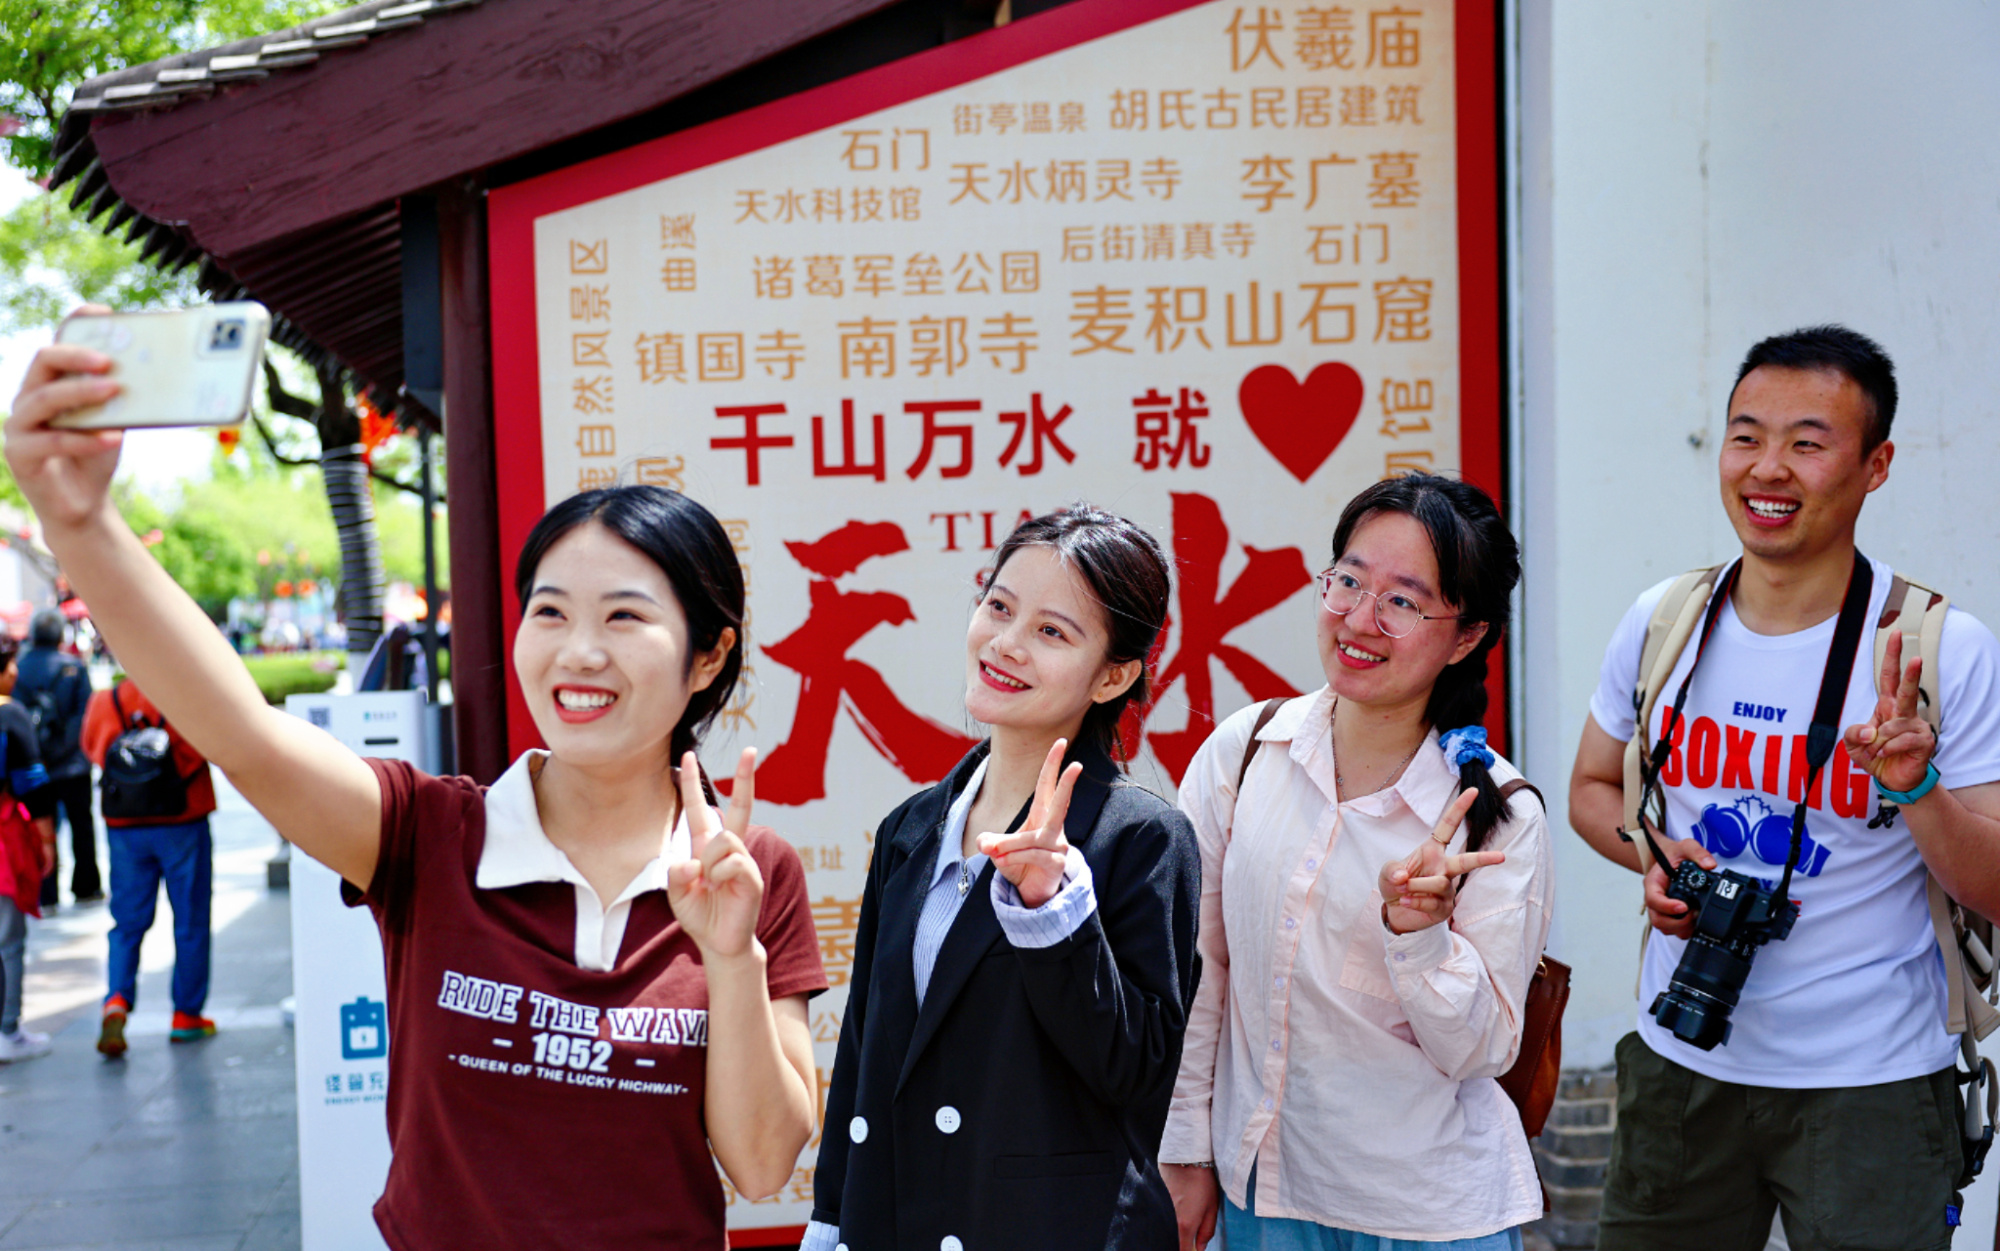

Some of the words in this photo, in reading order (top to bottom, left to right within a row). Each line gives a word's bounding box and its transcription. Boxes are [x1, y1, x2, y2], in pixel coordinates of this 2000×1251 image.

[1224, 5, 1423, 73] 伏羲庙
[953, 102, 1086, 135] 街亭温泉
[1109, 83, 1424, 131] 胡氏古民居建筑
[840, 127, 930, 172] 石门
[735, 187, 921, 224] 天水科技馆
[949, 158, 1181, 205] 天水炳灵寺
[1241, 151, 1422, 213] 李广墓
[1062, 222, 1256, 263] 后街清真寺
[1307, 223, 1390, 265] 石门
[752, 251, 1040, 300] 诸葛军垒公园
[1069, 276, 1434, 356] 麦积山石窟
[634, 330, 806, 385] 镇国寺
[837, 313, 1039, 380] 南郭寺
[710, 392, 1076, 486] 千山万水
[1132, 387, 1211, 471] 就
[1732, 701, 1788, 723] ENJOY
[1660, 705, 1871, 820] BOXING
[437, 969, 524, 1024] RIDE
[529, 990, 600, 1037] THE
[606, 1007, 708, 1047] WAV
[458, 1054, 509, 1074] QUEEN
[511, 1064, 533, 1077] OF
[535, 1065, 564, 1082] THE
[566, 1071, 616, 1090] LUCKY
[532, 1031, 614, 1073] 1952
